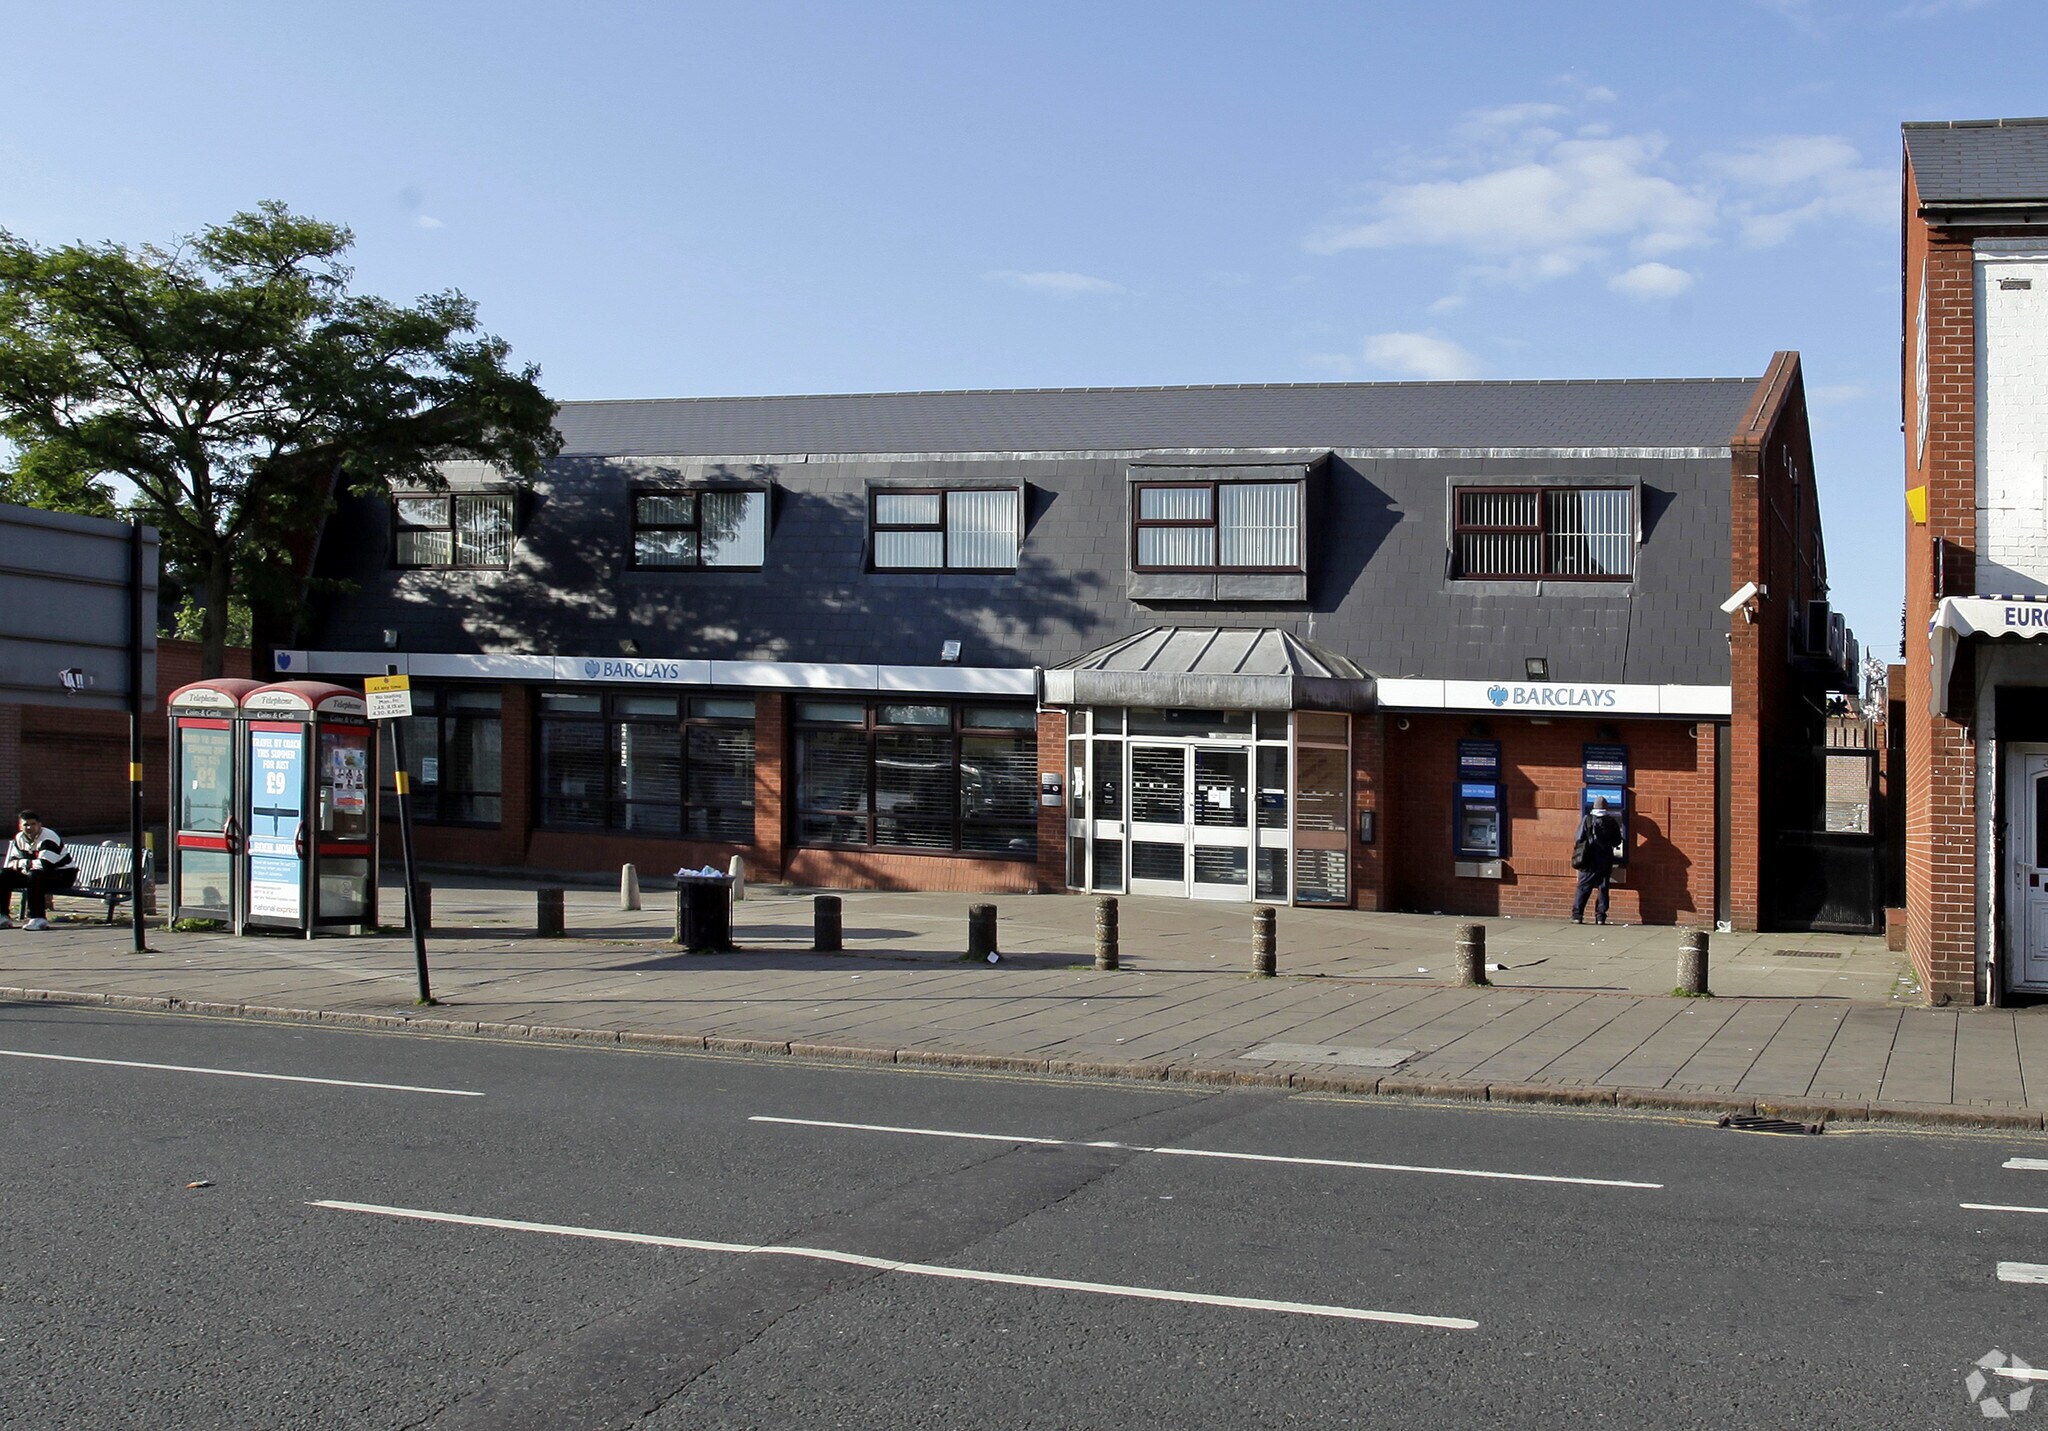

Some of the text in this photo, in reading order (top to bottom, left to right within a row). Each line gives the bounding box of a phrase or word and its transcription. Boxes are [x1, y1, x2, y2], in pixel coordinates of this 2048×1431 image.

[2005, 607, 2048, 627] EUR
[603, 662, 679, 679] BARCLAYS
[190, 694, 219, 704] Telephone
[261, 696, 293, 706] Telephone
[1513, 687, 1616, 707] BARCLAYS
[333, 700, 362, 710] Telephone
[278, 712, 294, 720] Cards
[252, 738, 273, 747] TRAVEL
[274, 738, 282, 748] BY
[257, 748, 296, 760] THIS SUMMER
[262, 760, 290, 770] FOR JUST
[266, 772, 286, 795] £9
[276, 906, 298, 914] express
